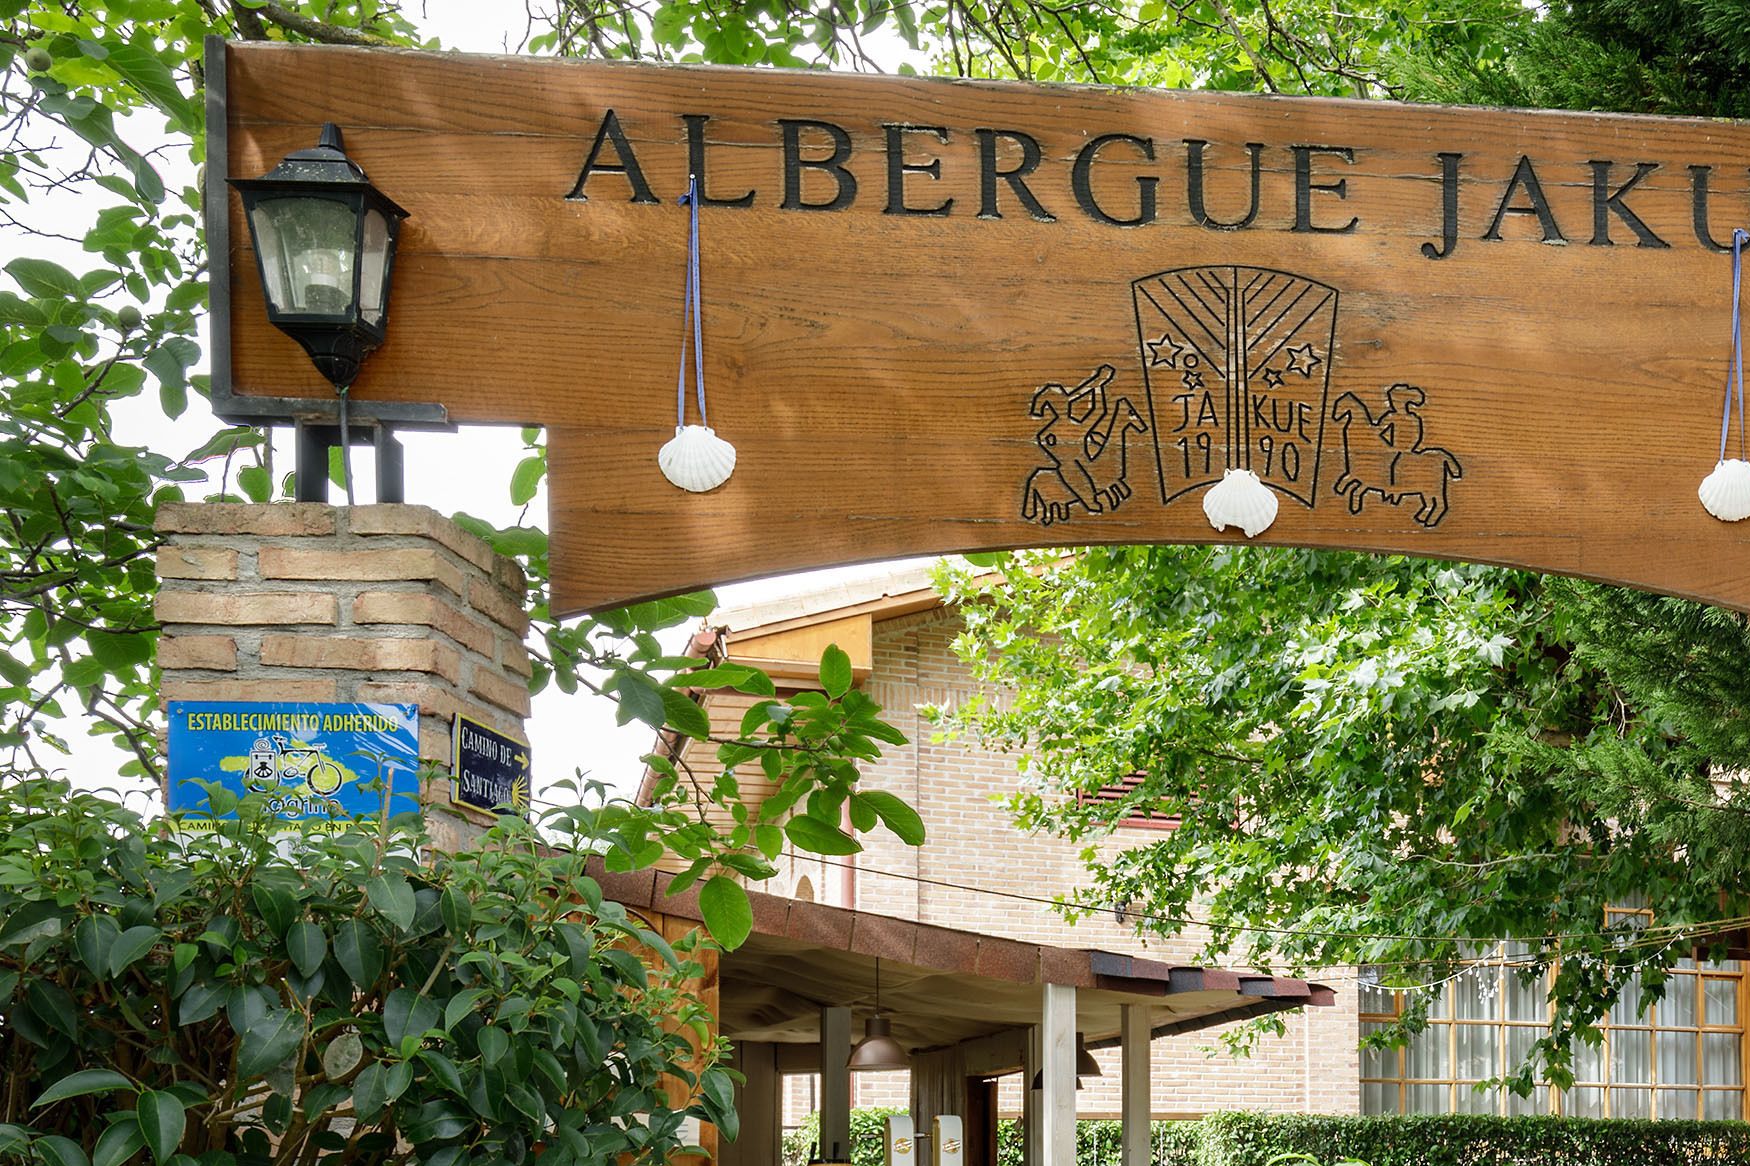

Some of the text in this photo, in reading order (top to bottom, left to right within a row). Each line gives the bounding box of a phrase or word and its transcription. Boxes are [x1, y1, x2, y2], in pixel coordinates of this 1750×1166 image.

[564, 108, 1359, 235] ALBERGUE
[1172, 391, 1312, 443] JA KUE
[1177, 432, 1300, 482] 19 90
[187, 712, 400, 733] ESTABLECIMIENTO ADHERIDO
[461, 727, 513, 767] CAMINO DE
